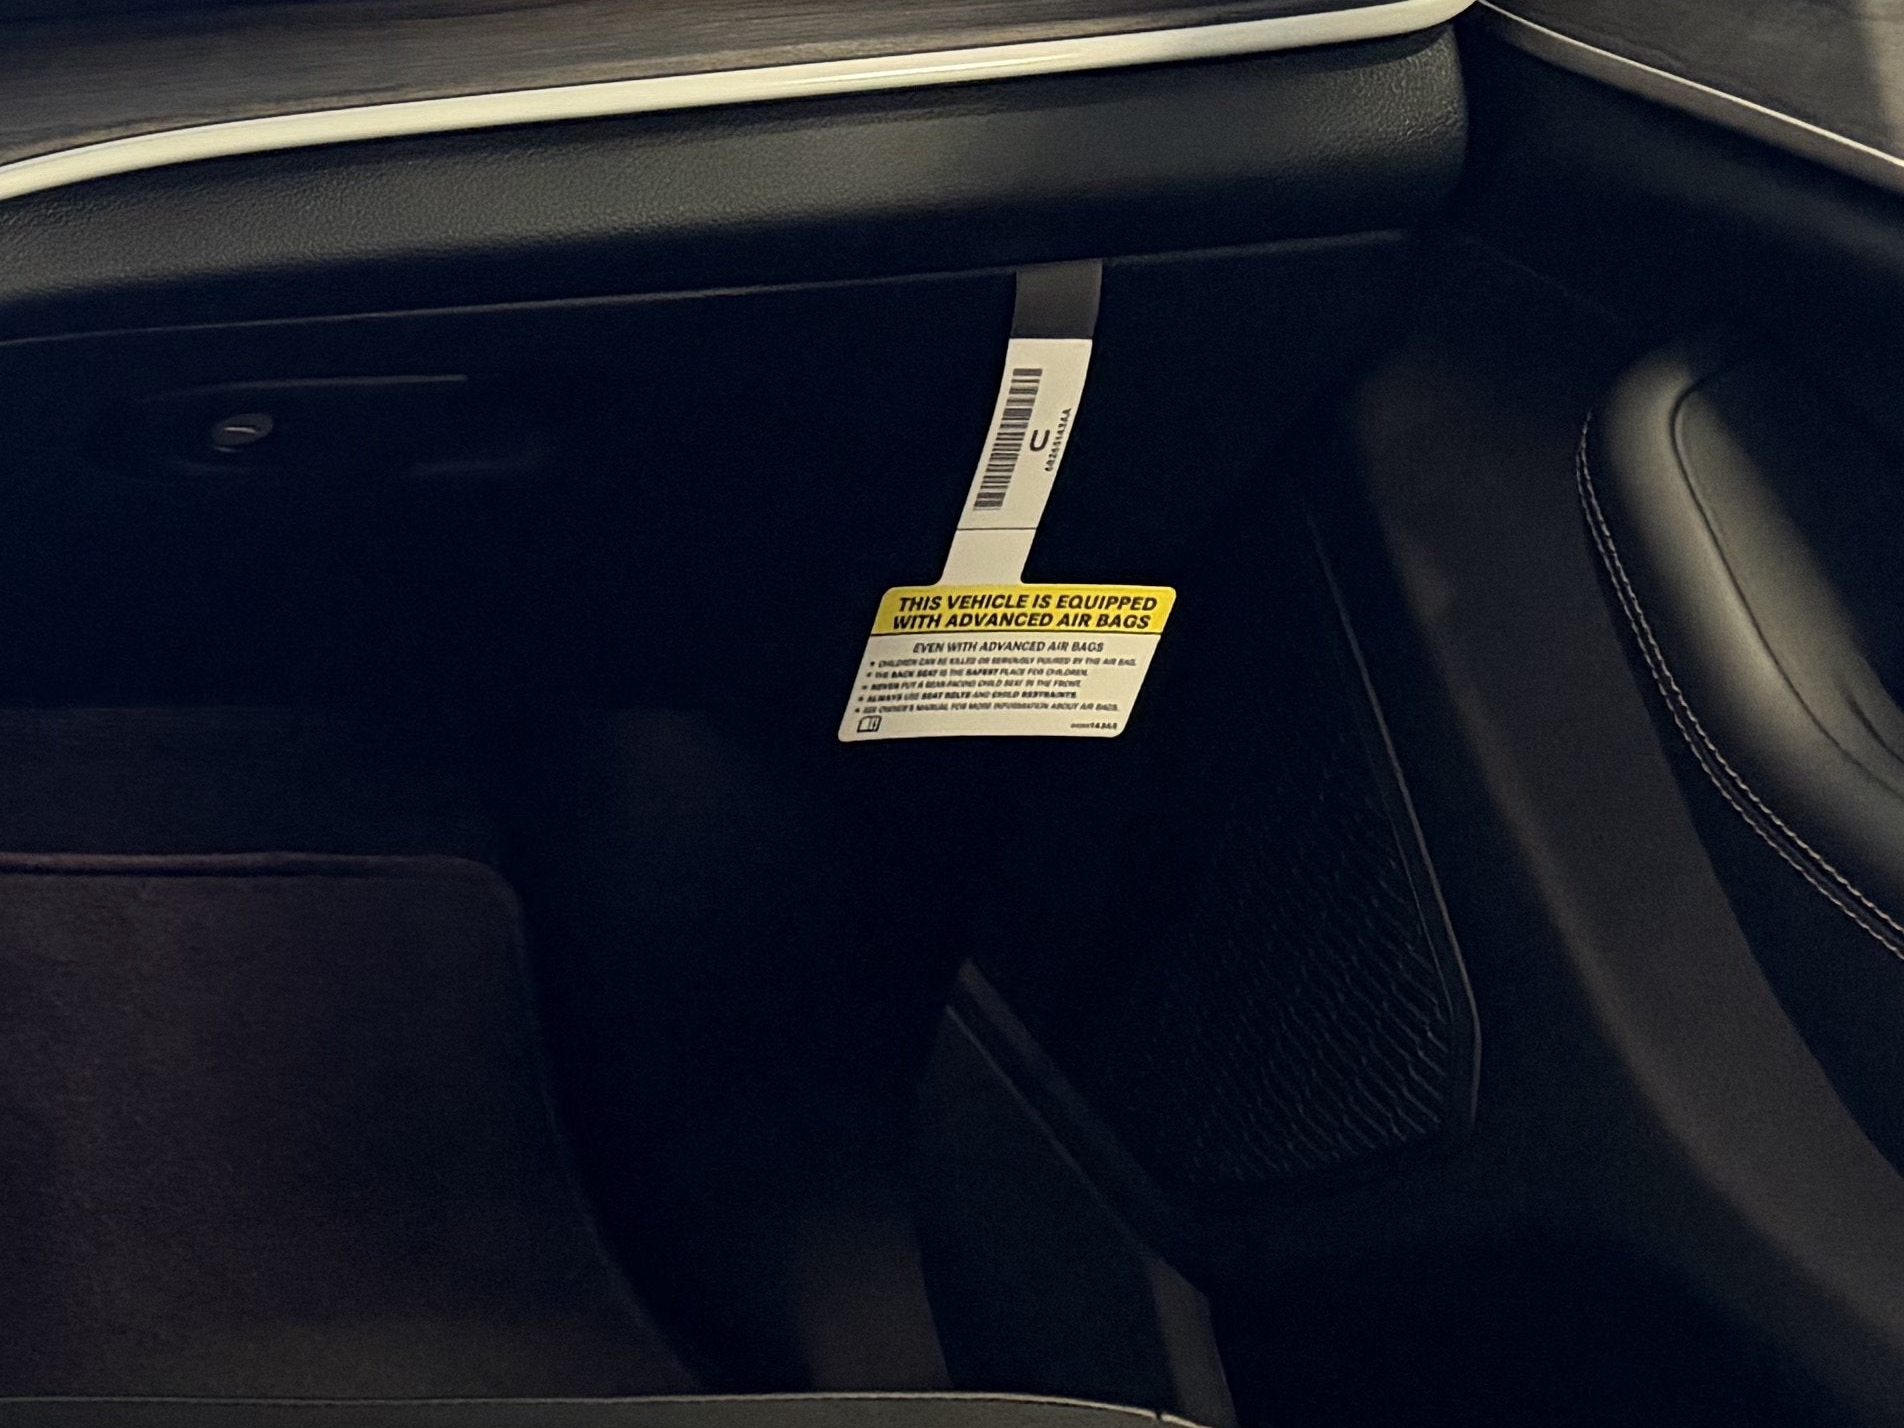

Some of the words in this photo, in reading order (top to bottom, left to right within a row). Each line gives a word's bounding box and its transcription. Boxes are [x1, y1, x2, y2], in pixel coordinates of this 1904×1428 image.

[898, 595, 942, 612] THIS
[947, 594, 1030, 610] VEHICLE
[1031, 594, 1053, 610] IS
[1055, 594, 1158, 612] EQUIPPED
[892, 613, 942, 630] WITH
[944, 612, 1054, 629] ADVANCED
[1056, 613, 1093, 628] AIR
[1095, 613, 1152, 630] BAGS
[912, 642, 944, 654] EVEN
[947, 641, 977, 653] WITH
[979, 640, 1046, 653] ADVANCED
[1047, 641, 1068, 652] AIR
[1071, 641, 1105, 653] BAGS
